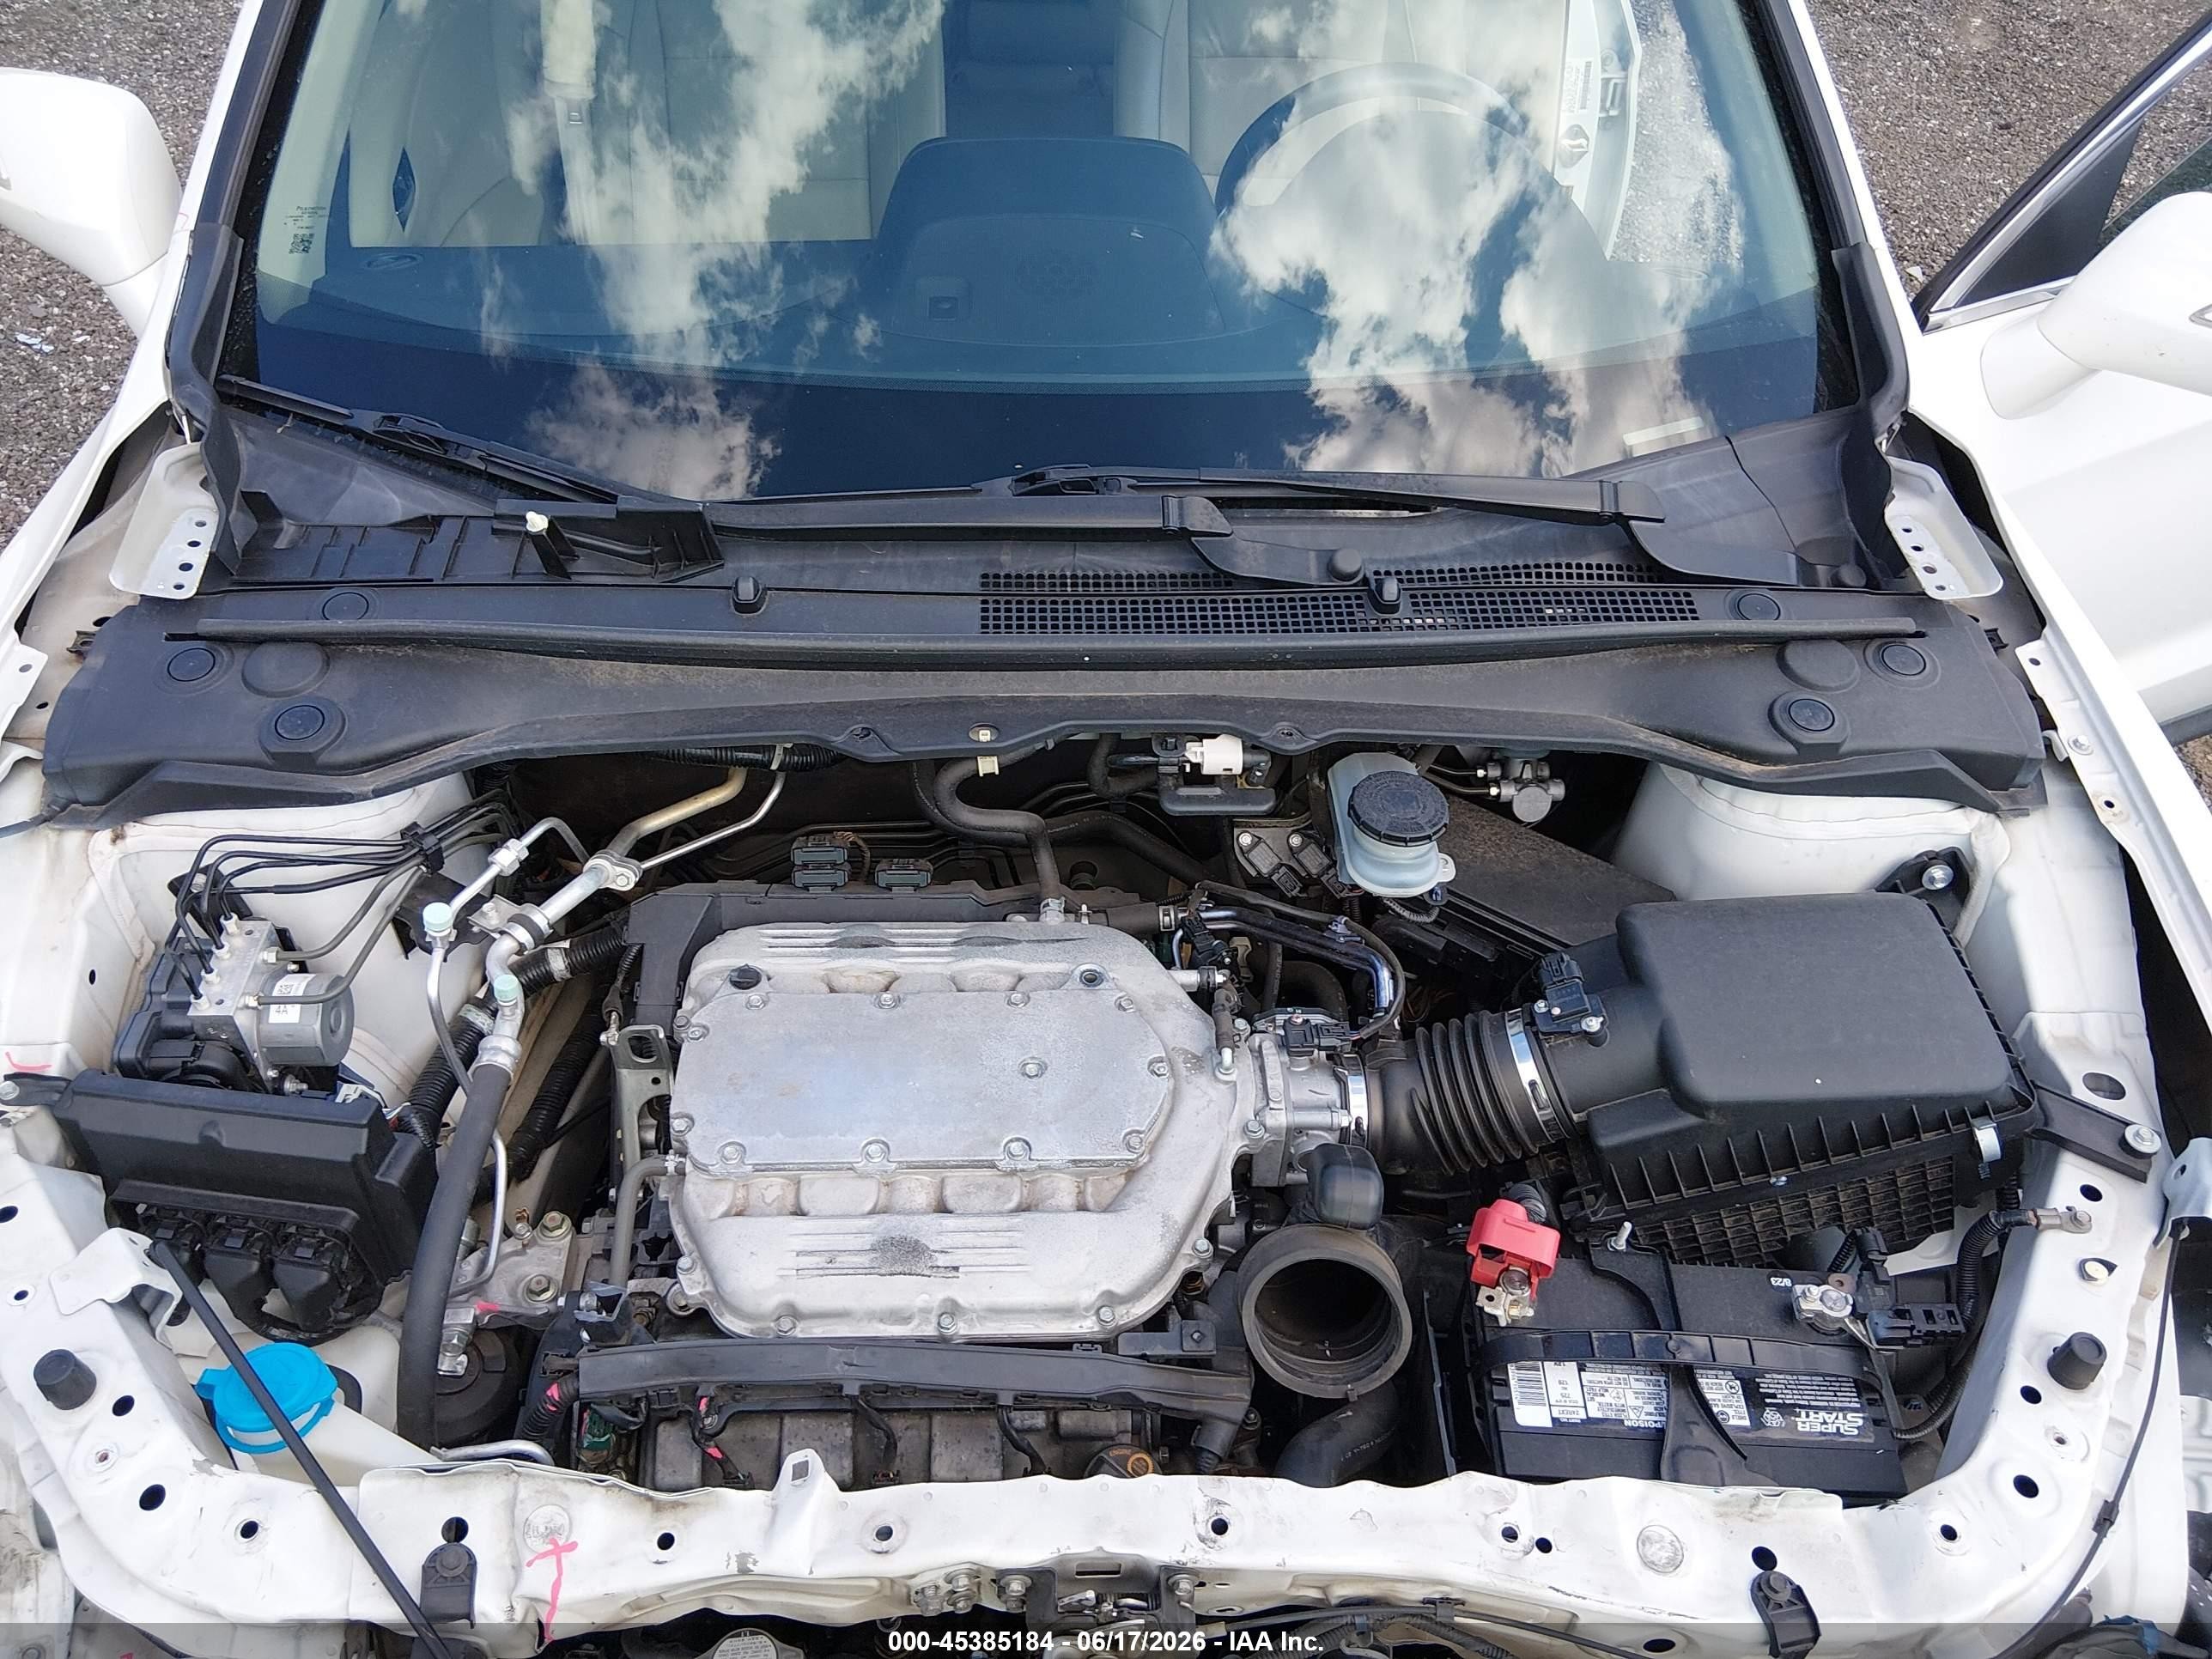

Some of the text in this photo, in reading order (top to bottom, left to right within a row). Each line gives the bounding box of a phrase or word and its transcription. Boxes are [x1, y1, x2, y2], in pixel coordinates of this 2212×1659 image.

[1770, 1277, 1792, 1287] 8/23
[1796, 1411, 1863, 1427] START
[1797, 1421, 1859, 1436] SUPER
